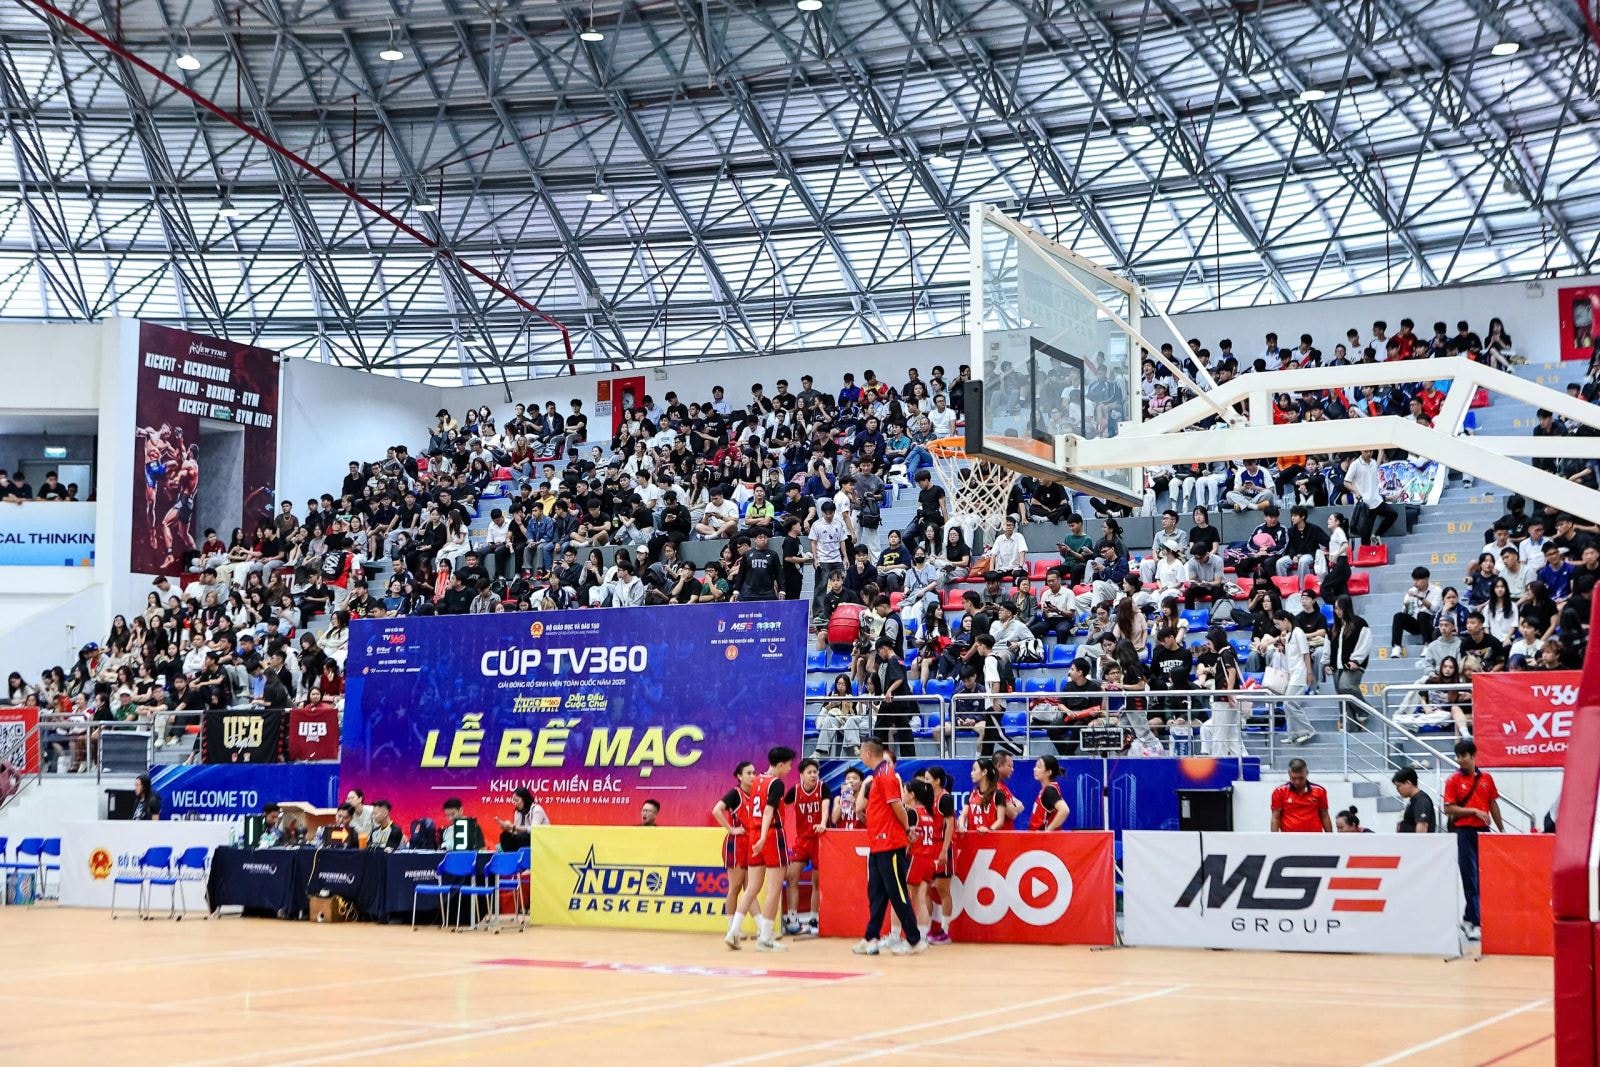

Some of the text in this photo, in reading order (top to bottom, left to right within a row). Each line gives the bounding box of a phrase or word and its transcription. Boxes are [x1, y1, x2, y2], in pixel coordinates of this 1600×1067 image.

[144, 352, 231, 383] KICKFIT KICKBOXING
[157, 375, 261, 408] MUAYTHAI BOXING GYM
[178, 398, 210, 419] KICKFIT
[235, 409, 254, 425] GYM
[253, 413, 273, 428] KIDS
[1447, 522, 1472, 534] B 07
[751, 559, 768, 569] UTC
[1431, 553, 1456, 565] B 06
[730, 622, 753, 631] MSE
[480, 645, 648, 677] CÚP TV360
[525, 679, 535, 688] RỔ
[535, 680, 549, 688] SINH
[549, 679, 562, 687] VIÊN
[562, 679, 579, 687] TOÀN
[579, 678, 596, 686] QUỐC
[564, 700, 586, 709] Cuộc
[222, 715, 264, 749] UEB
[298, 721, 328, 736] UEB
[420, 713, 705, 778] LỄ BẾ MẠC
[1505, 744, 1538, 756] THEO
[490, 773, 622, 794] KHU VỰC MIỀN BẮC
[171, 790, 258, 808] WELCOME TO
[545, 796, 554, 804] 27
[555, 795, 581, 804] THÁNG
[582, 796, 591, 804] 10
[592, 795, 610, 804] NĂM
[611, 796, 630, 804] 2025
[752, 795, 763, 817] 2
[798, 801, 820, 814] VNU
[1174, 854, 1401, 911] MSE
[1231, 917, 1342, 934] GROUP
